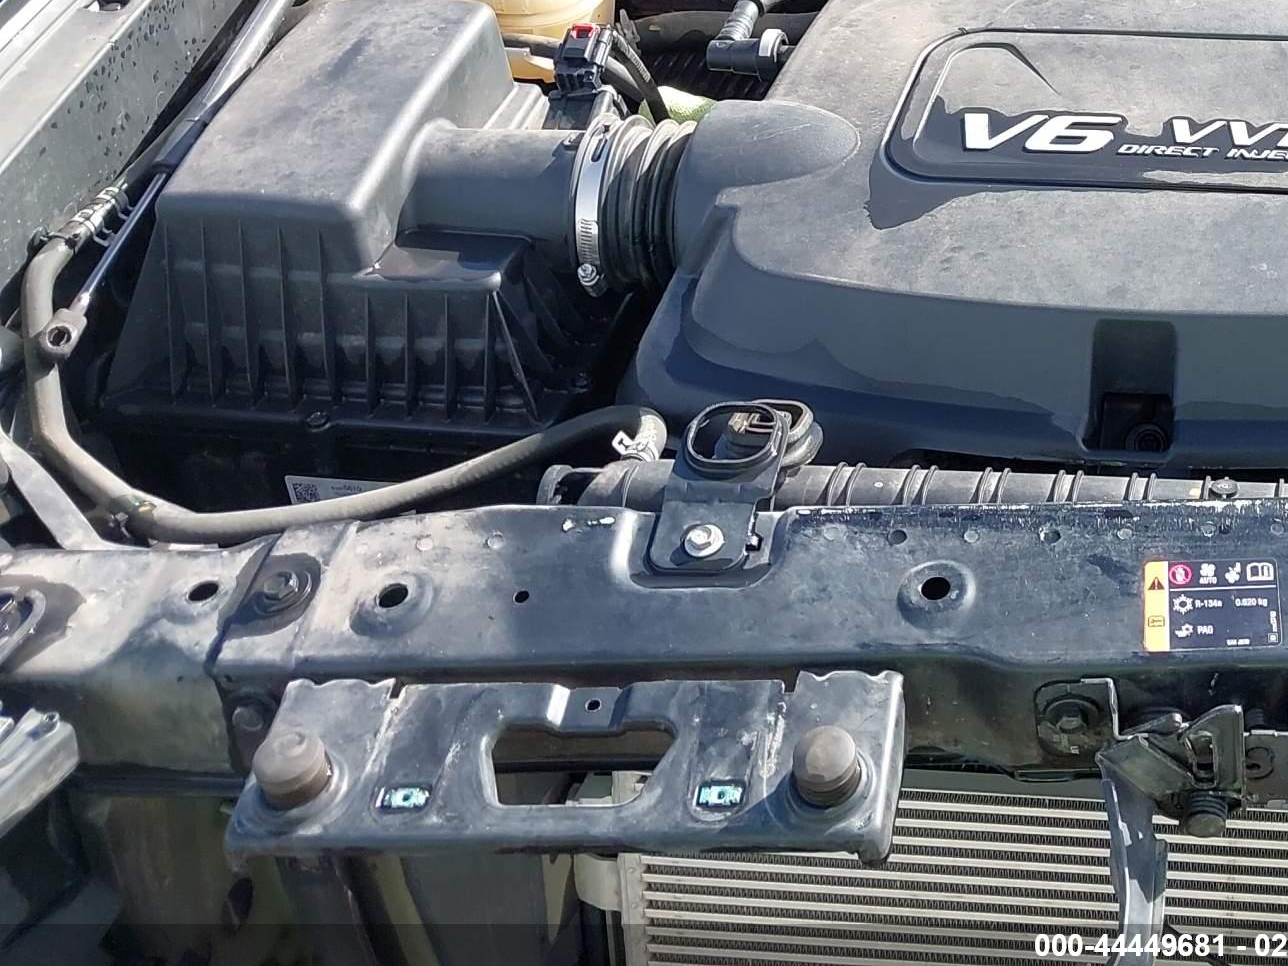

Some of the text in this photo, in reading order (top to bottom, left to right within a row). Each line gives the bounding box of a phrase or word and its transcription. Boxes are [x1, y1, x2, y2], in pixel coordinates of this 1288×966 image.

[963, 112, 1123, 153] V6
[1118, 143, 1219, 158] DIRECT
[1195, 599, 1223, 608] R-134a
[1257, 598, 1268, 607] kg
